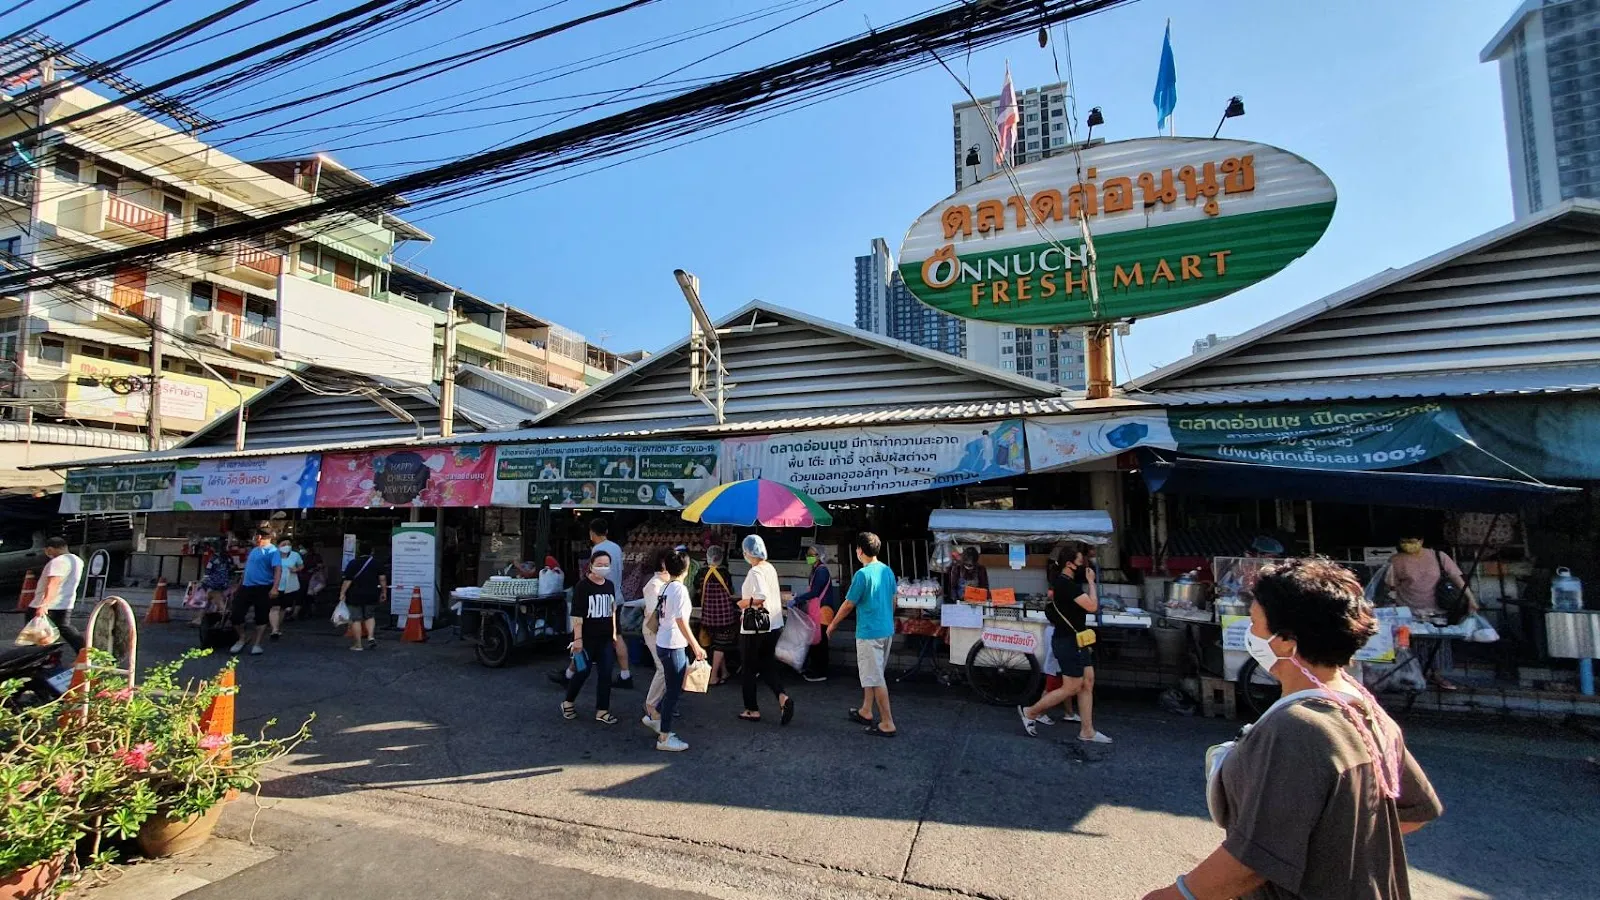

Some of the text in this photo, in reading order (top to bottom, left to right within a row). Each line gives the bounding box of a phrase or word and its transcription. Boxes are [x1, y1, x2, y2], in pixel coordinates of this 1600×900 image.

[941, 154, 1255, 239] ตลาดอ่อนนุช
[921, 243, 1088, 288] ONNUCH
[971, 250, 1232, 306] FRESH MART
[1179, 413, 1301, 431] ตลาดอ่อนนุช
[681, 444, 715, 452] COVID-19
[769, 435, 960, 454] ตลาดอ่อนนุช มีการทำความสะอาด
[788, 455, 804, 468] พื้น
[808, 457, 824, 467] โต๊ะ
[829, 452, 854, 466] เก้าอี้
[1363, 444, 1427, 464] 100%
[391, 463, 414, 471] HAPPY
[893, 466, 910, 475] 1-2
[387, 473, 416, 482] CHINESE
[384, 485, 417, 494] NEW YEAR
